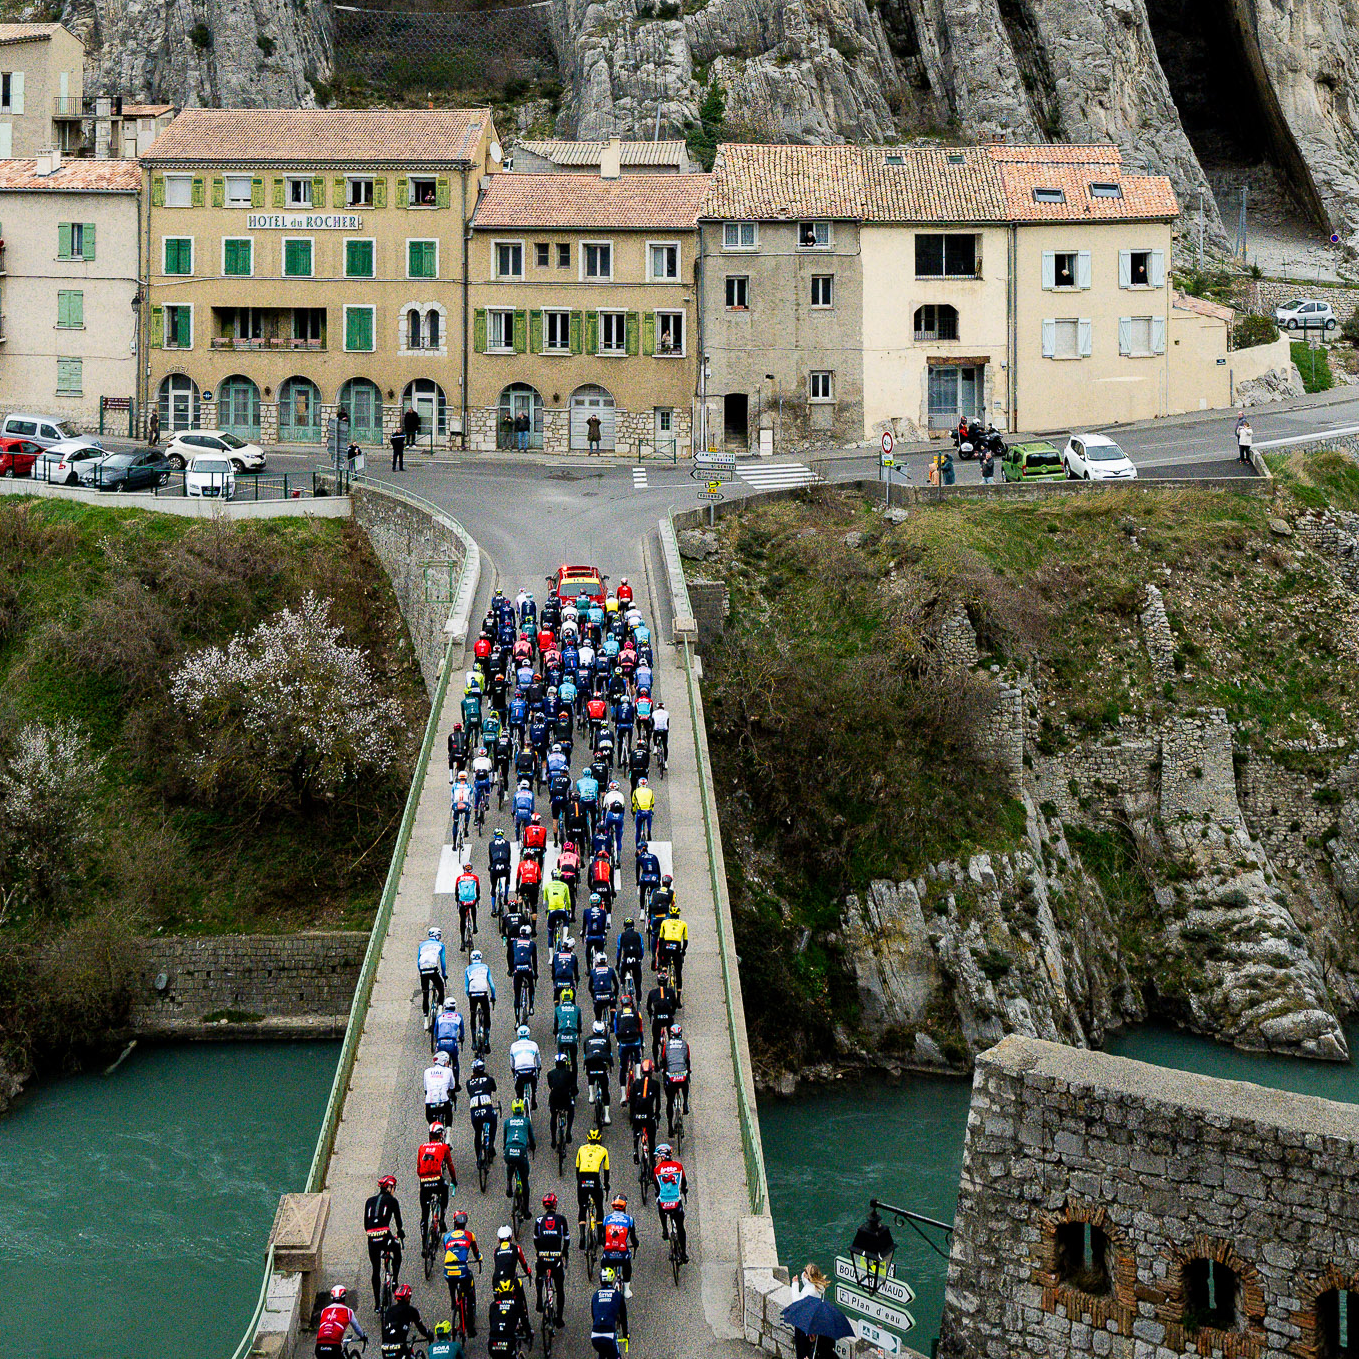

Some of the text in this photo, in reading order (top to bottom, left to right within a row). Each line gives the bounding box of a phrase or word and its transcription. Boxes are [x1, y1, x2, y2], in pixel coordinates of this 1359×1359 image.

[248, 216, 356, 228] HOTEL du ROCHER
[852, 1296, 870, 1311] Plan
